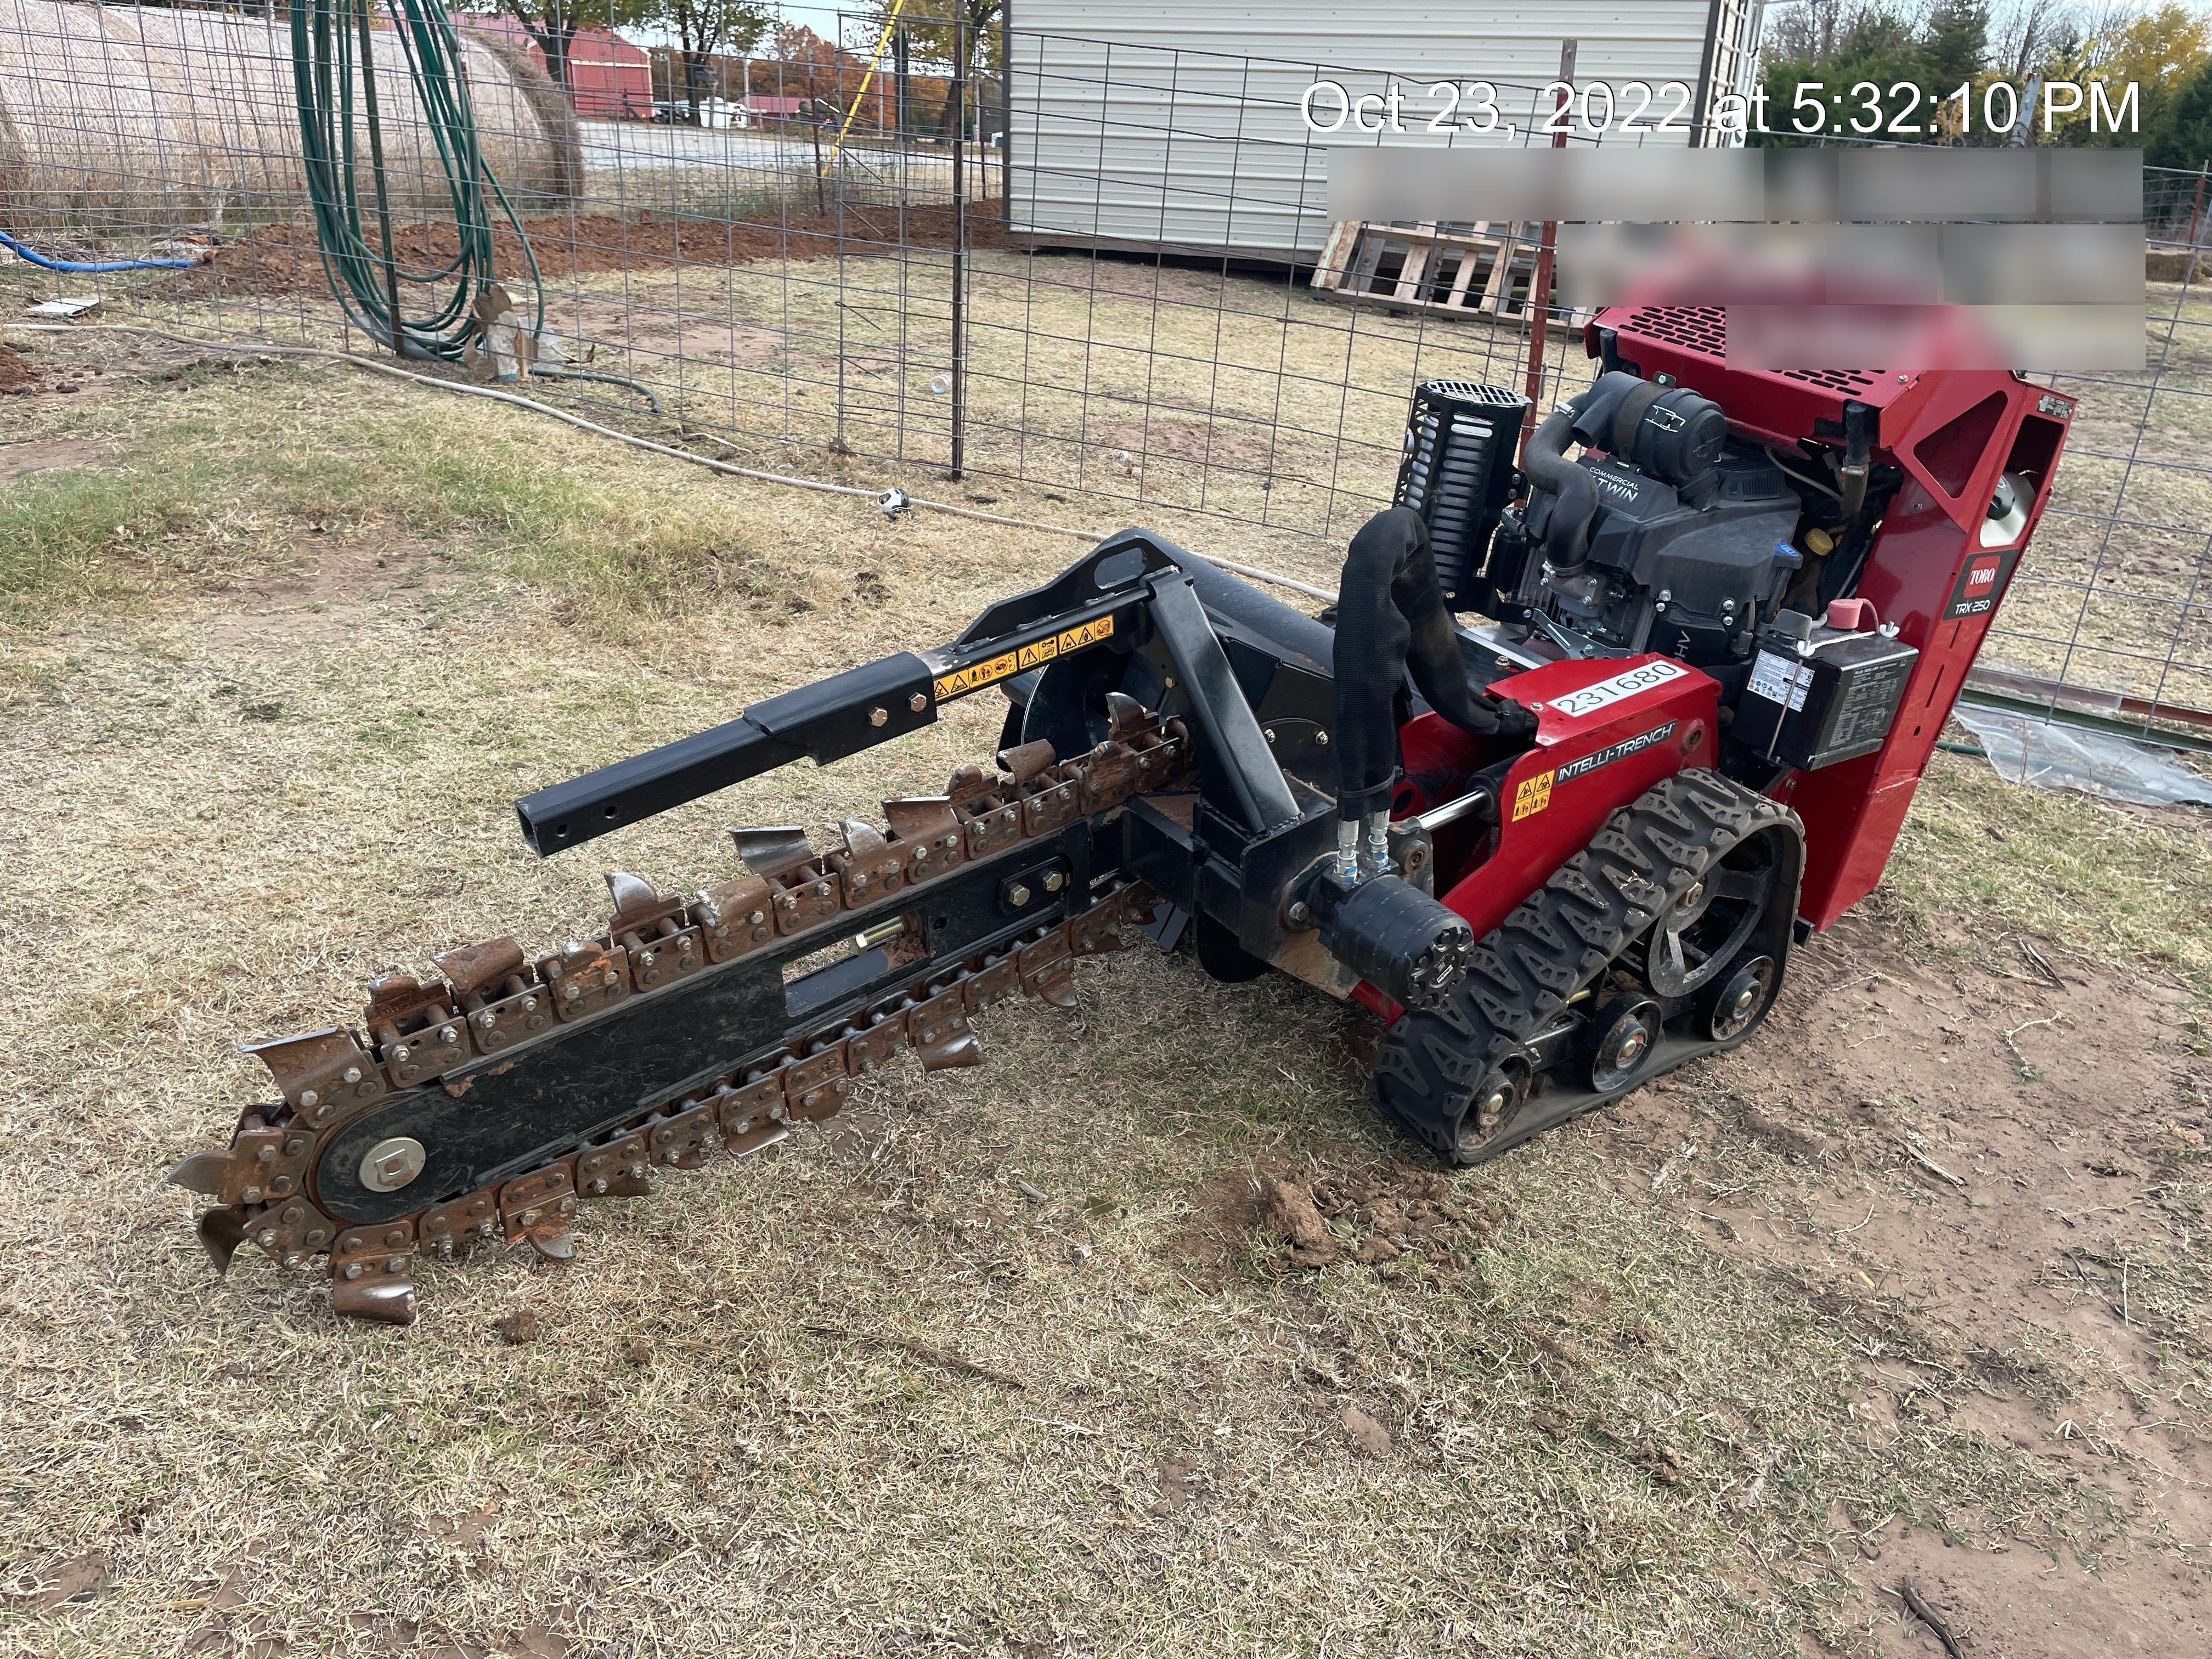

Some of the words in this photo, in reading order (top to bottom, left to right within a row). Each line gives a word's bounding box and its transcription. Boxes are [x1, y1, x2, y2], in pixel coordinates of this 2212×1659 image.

[1589, 467, 1639, 490] COMMERCIAL
[1970, 568, 1995, 585] TORO
[1674, 630, 1691, 662] HV
[1557, 664, 1678, 713] 231680
[1558, 723, 1674, 782] INTELLI-TRENCH
